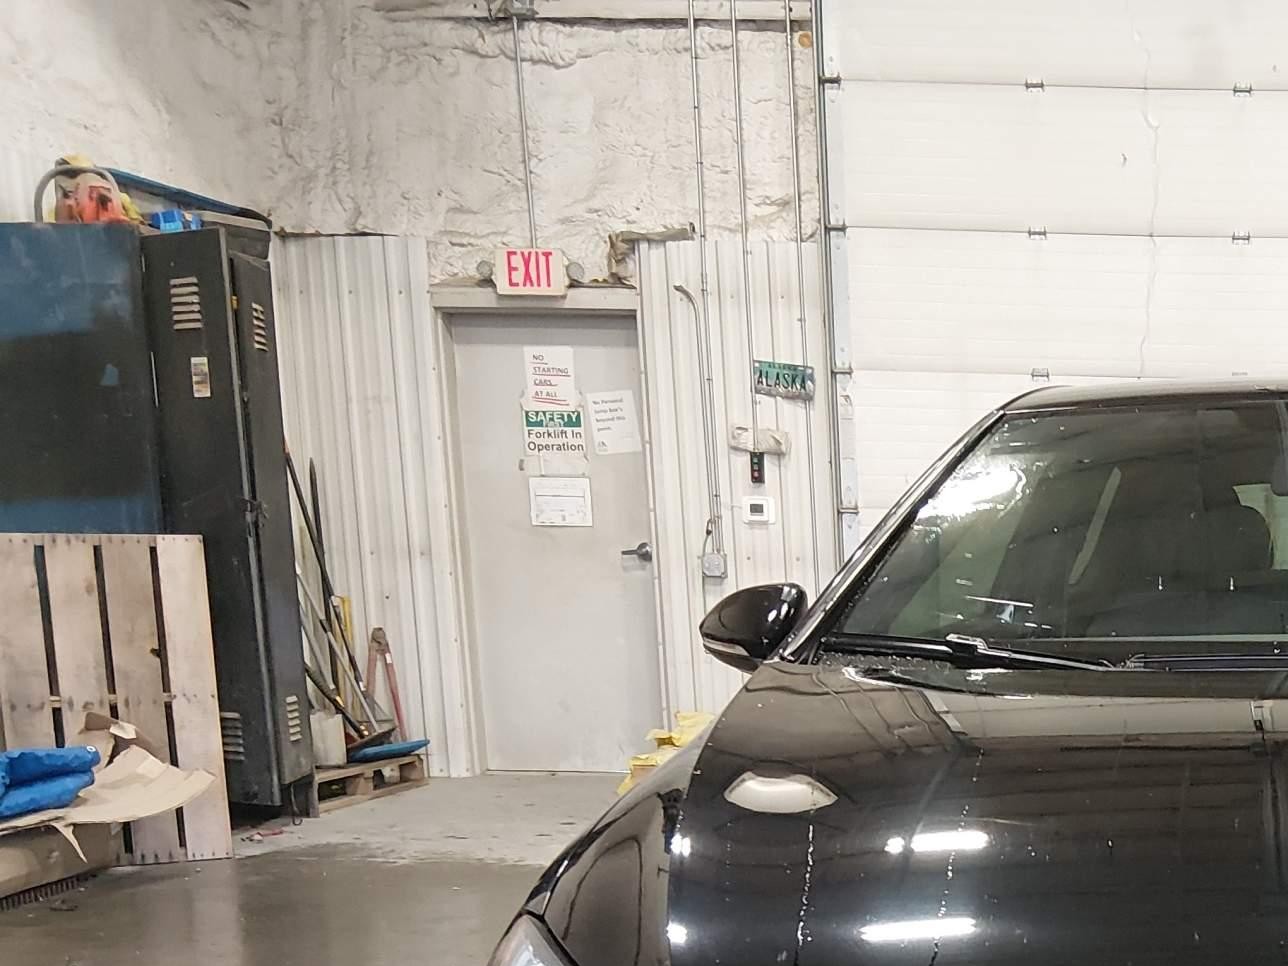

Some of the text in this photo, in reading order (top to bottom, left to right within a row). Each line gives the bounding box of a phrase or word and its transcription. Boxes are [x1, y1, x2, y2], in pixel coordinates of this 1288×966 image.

[506, 251, 553, 288] EXIT
[533, 366, 569, 374] STARTING
[757, 369, 807, 392] ALASKA
[527, 411, 578, 422] SAFETY
[527, 429, 582, 439] Forklift In
[527, 442, 584, 452] Operation
